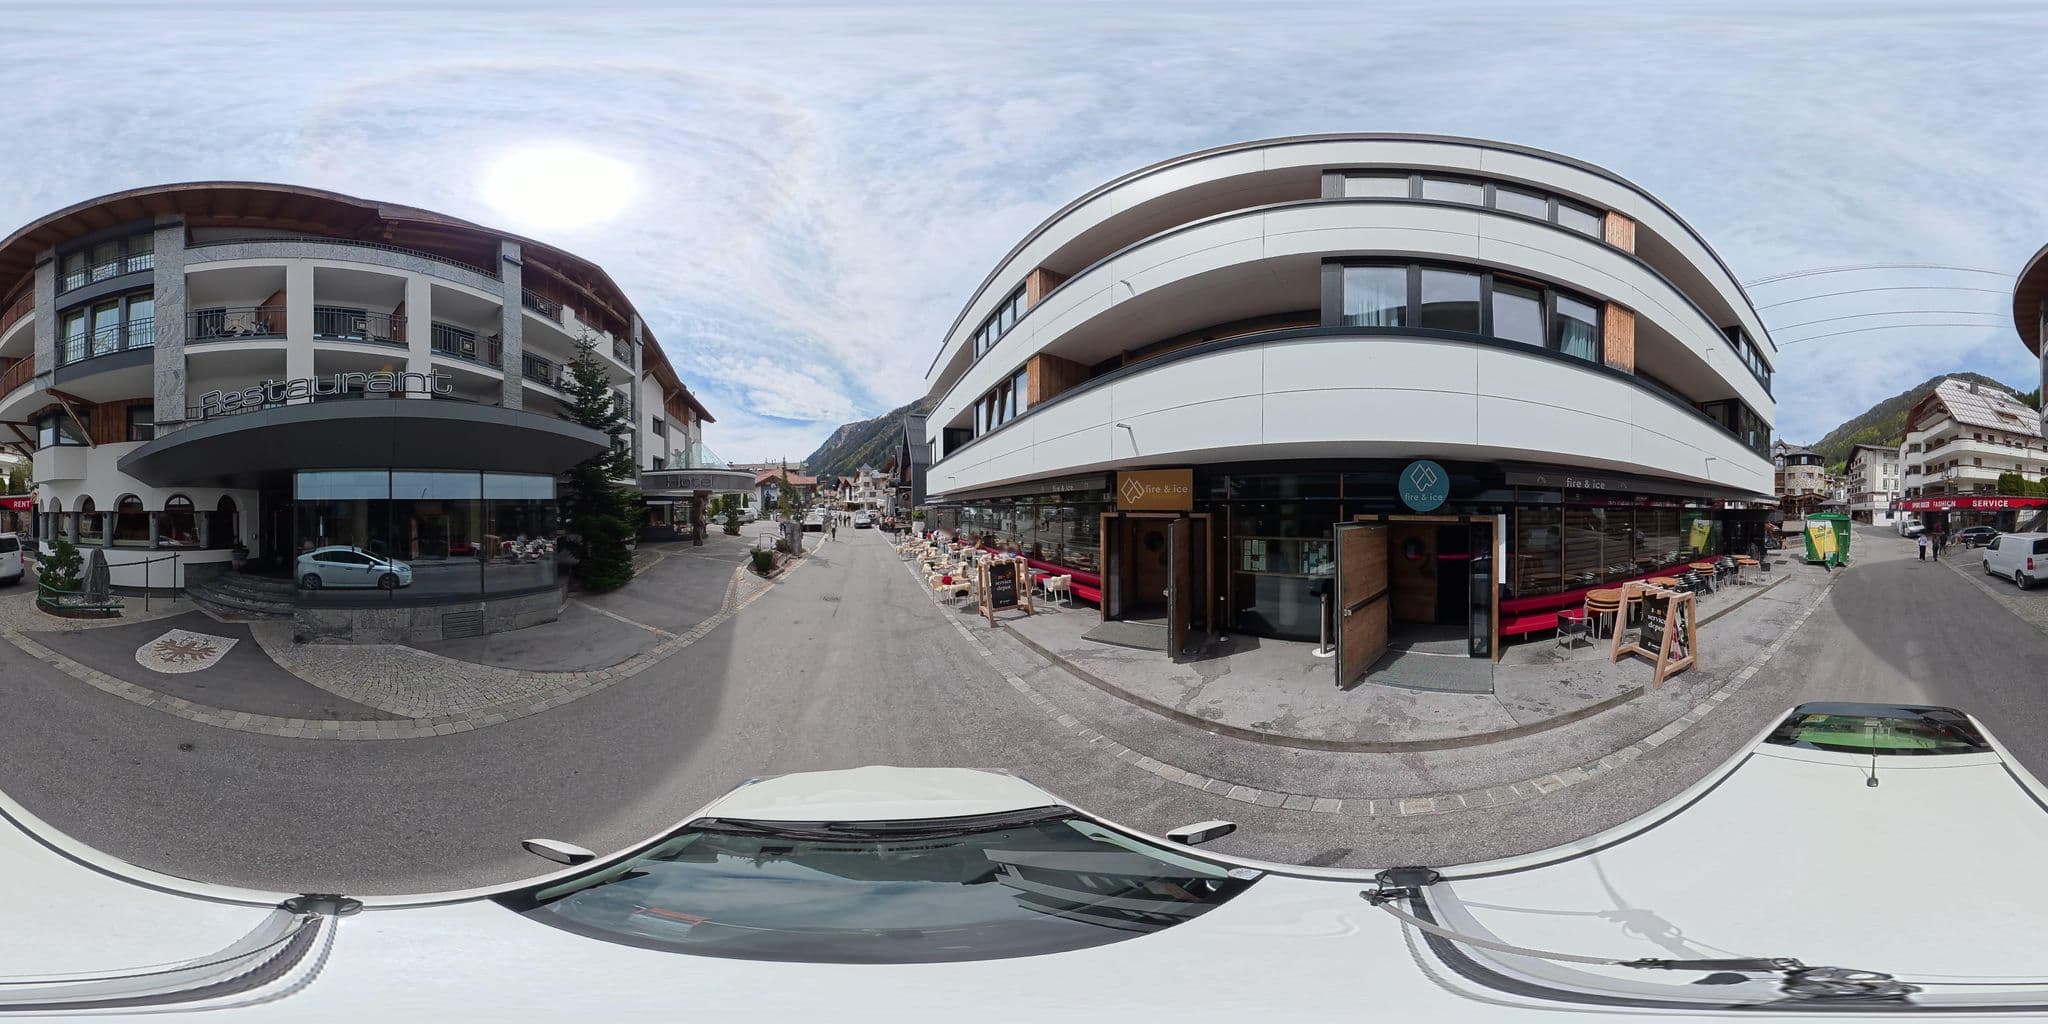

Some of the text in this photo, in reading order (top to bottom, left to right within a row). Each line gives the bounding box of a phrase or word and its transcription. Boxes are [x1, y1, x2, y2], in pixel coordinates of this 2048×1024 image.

[199, 369, 453, 419] Restaurant
[667, 474, 713, 488] Hotel
[1566, 477, 1605, 490] fire & ice
[1145, 484, 1188, 494] fire & ice
[1405, 493, 1419, 501] fire
[1430, 493, 1443, 501] ice
[13, 500, 30, 508] RENT
[1972, 500, 2009, 508] SERVICE
